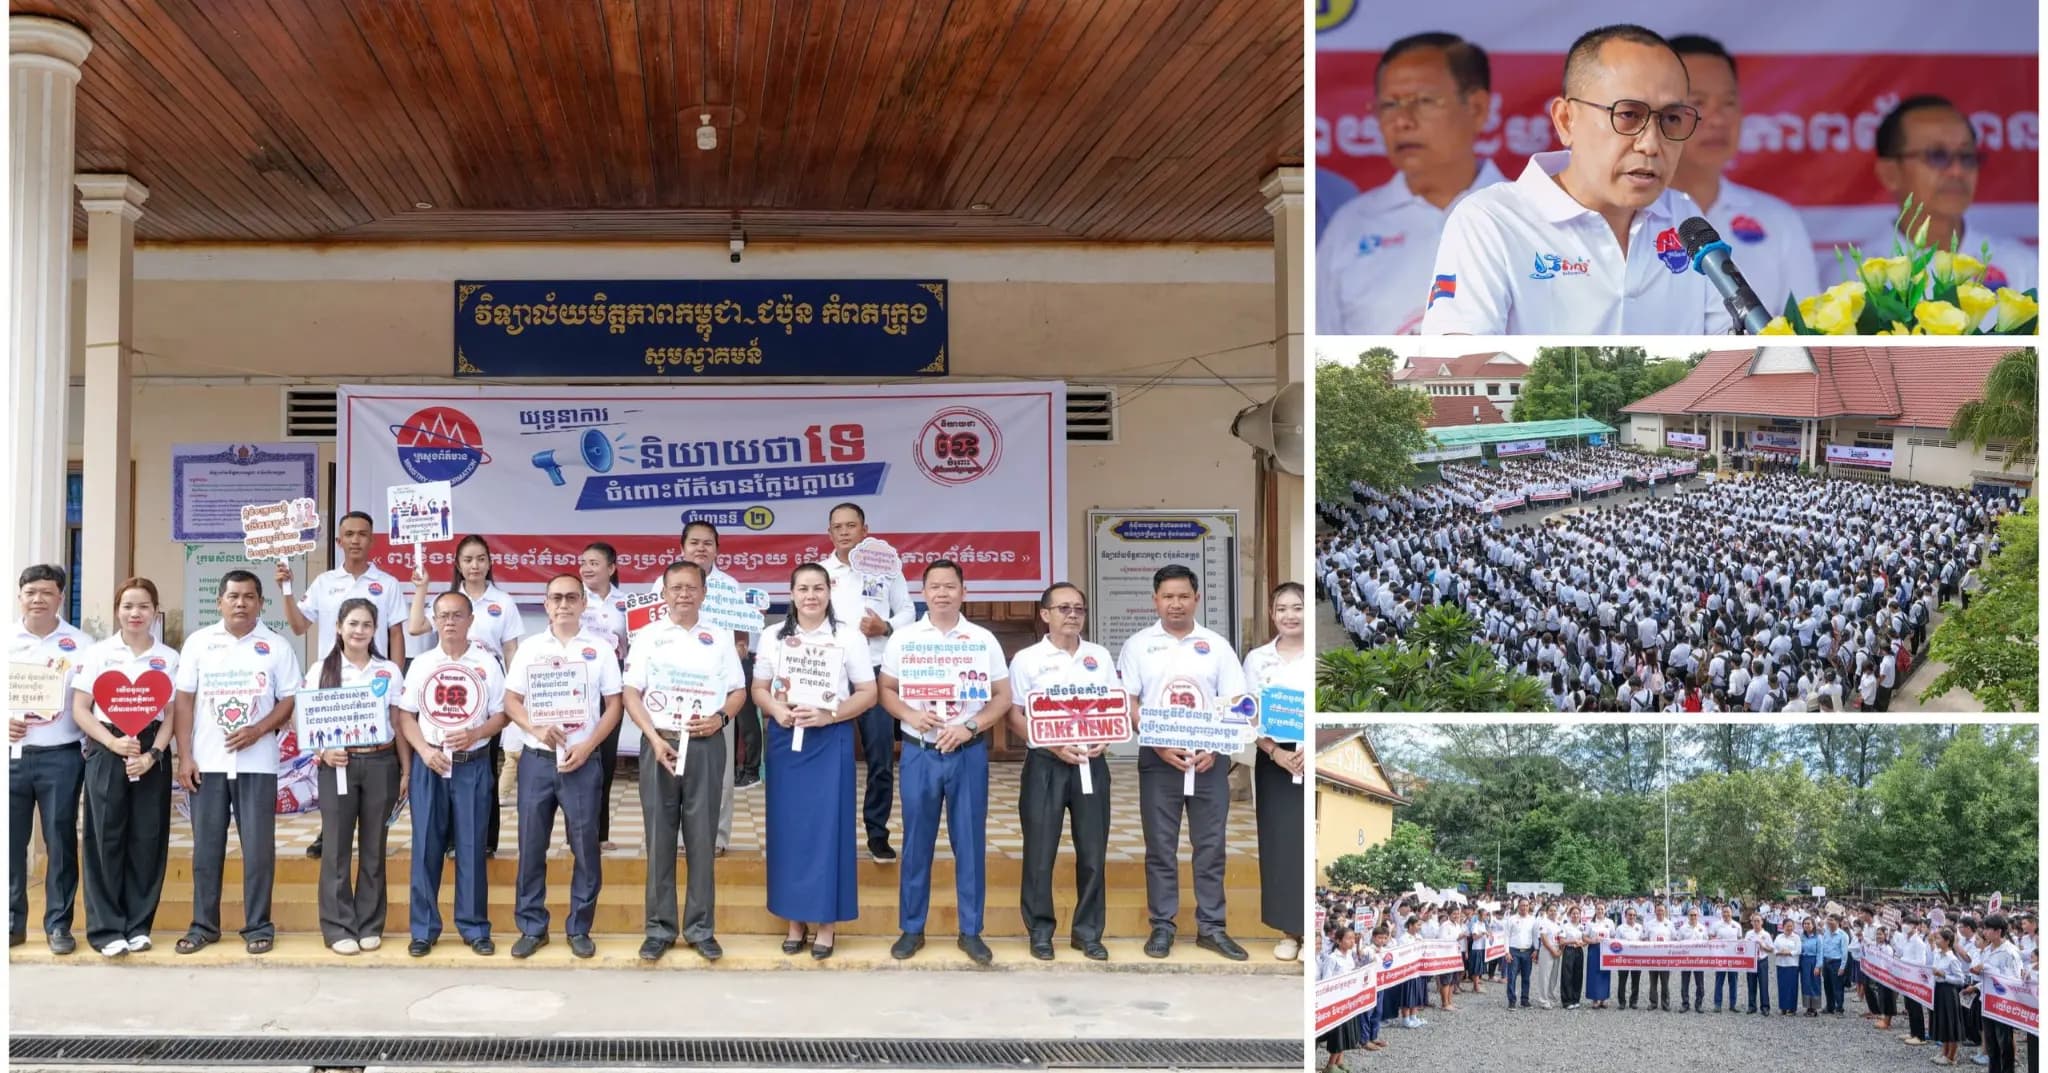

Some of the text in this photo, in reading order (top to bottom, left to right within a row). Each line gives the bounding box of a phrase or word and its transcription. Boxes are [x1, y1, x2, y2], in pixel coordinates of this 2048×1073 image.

[822, 294, 928, 336] កំពតក្រុង
[644, 337, 763, 374] សូមស្វាគមន៍
[519, 406, 609, 430] យុទ្ធនាការ
[1036, 718, 1124, 739] FAKE NEWS
